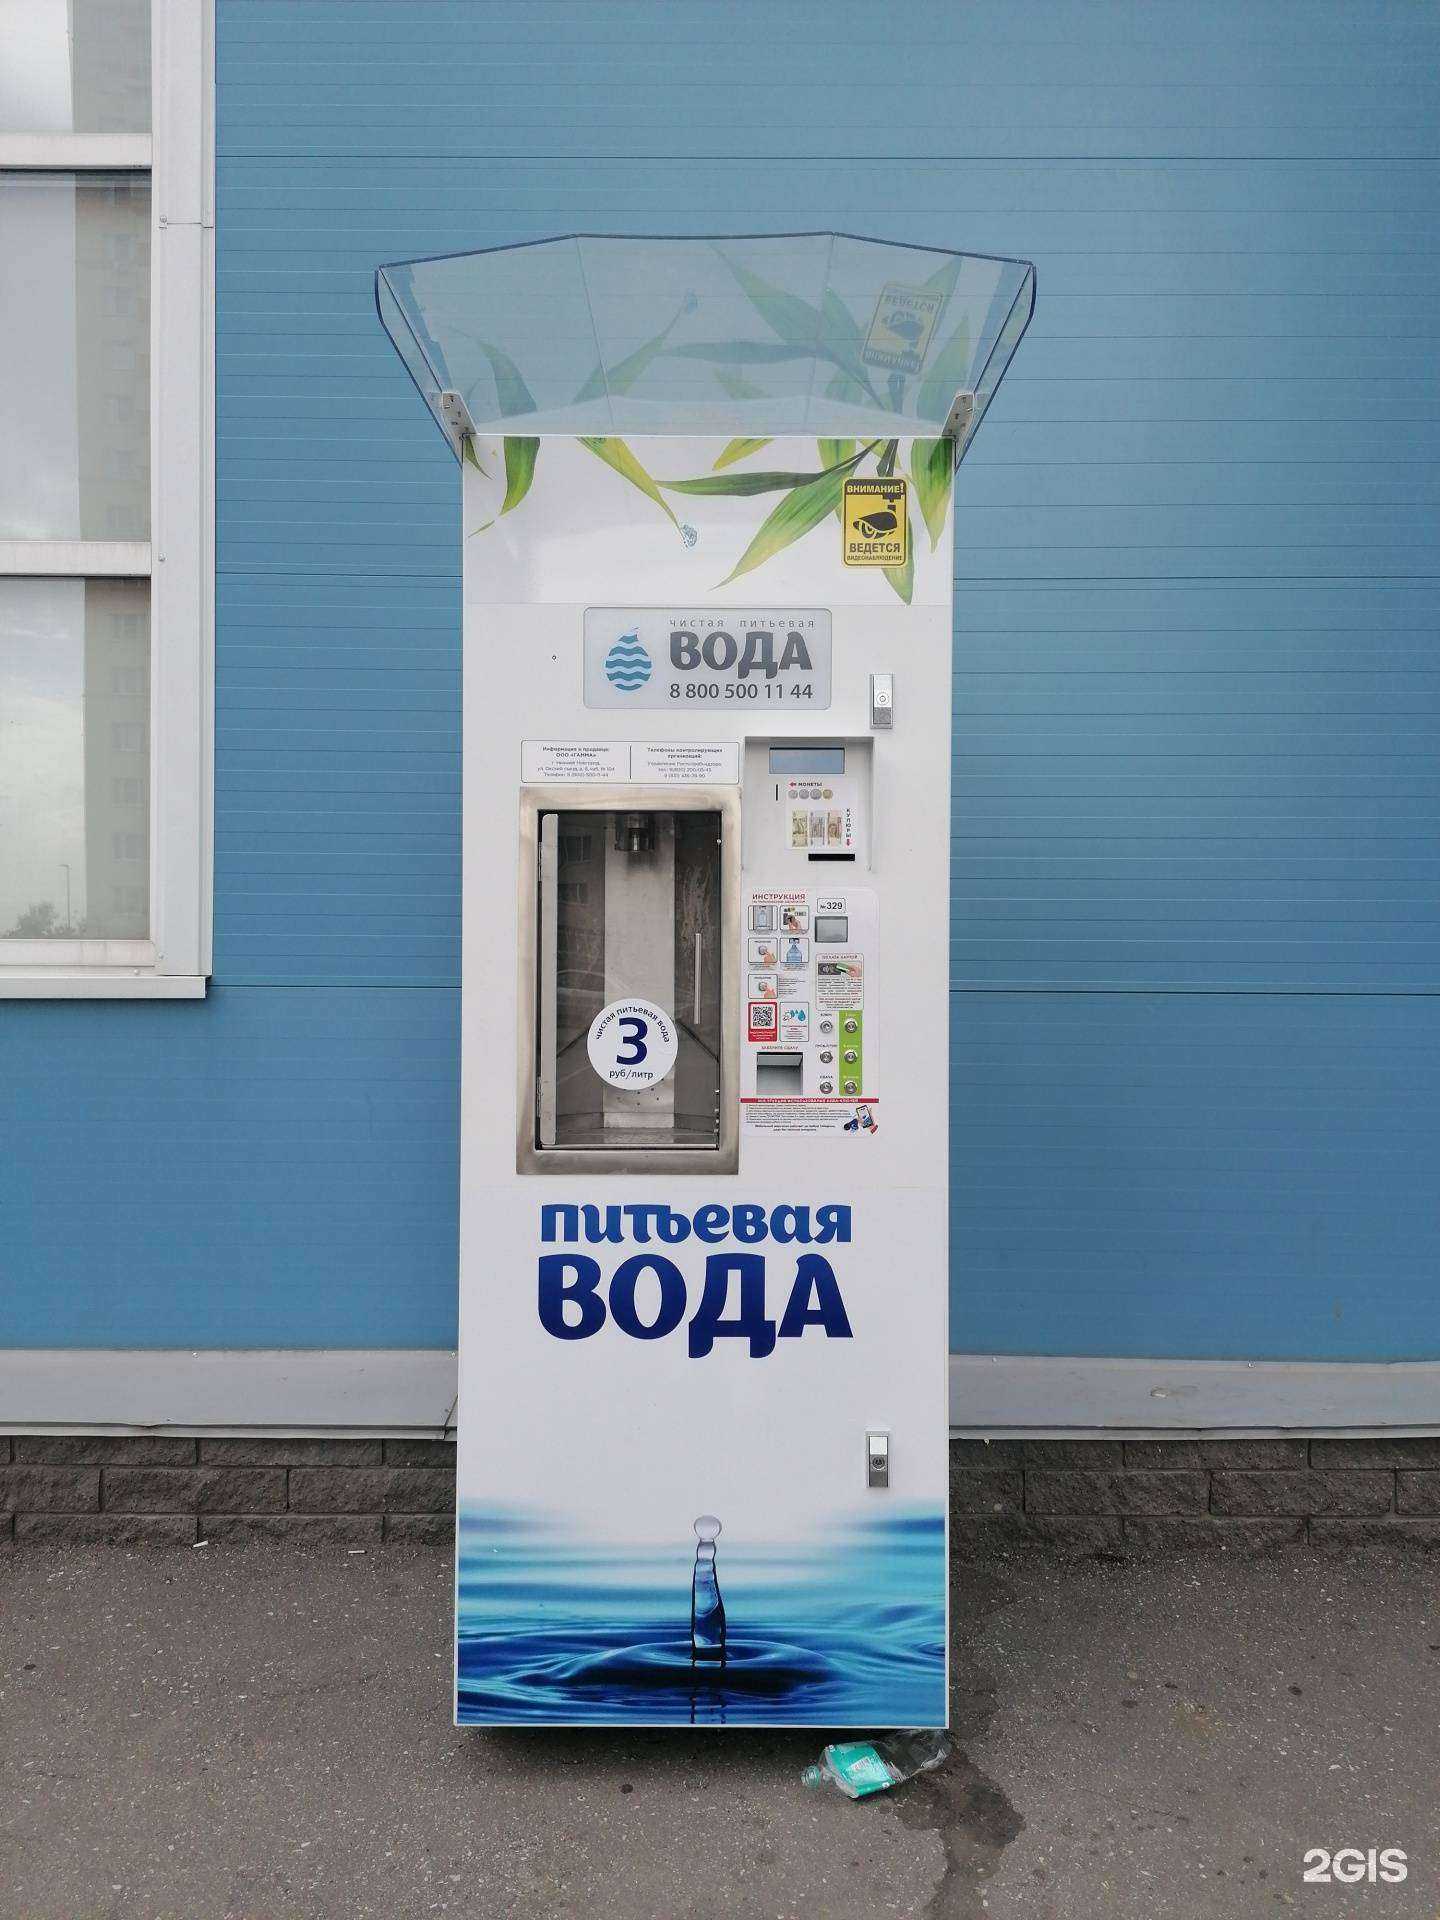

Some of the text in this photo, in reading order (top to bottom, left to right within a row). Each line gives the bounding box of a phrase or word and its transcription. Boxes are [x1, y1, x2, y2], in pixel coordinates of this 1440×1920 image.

[847, 483, 904, 494] ВНИМАНИЕ!
[850, 543, 900, 554] ВЕДЕТСЯ
[670, 620, 815, 629] чистая питьевая
[669, 631, 813, 680] ВОДА
[669, 684, 813, 699] 8 800 500 11 44
[752, 893, 806, 901] ИНСТРУКЦИЯ
[596, 1006, 670, 1043] чистая питьевая вода
[616, 1016, 648, 1065] 3
[609, 1069, 654, 1080] руб/литр
[541, 1203, 852, 1244] питьевая
[538, 1252, 854, 1359] ВОДА
